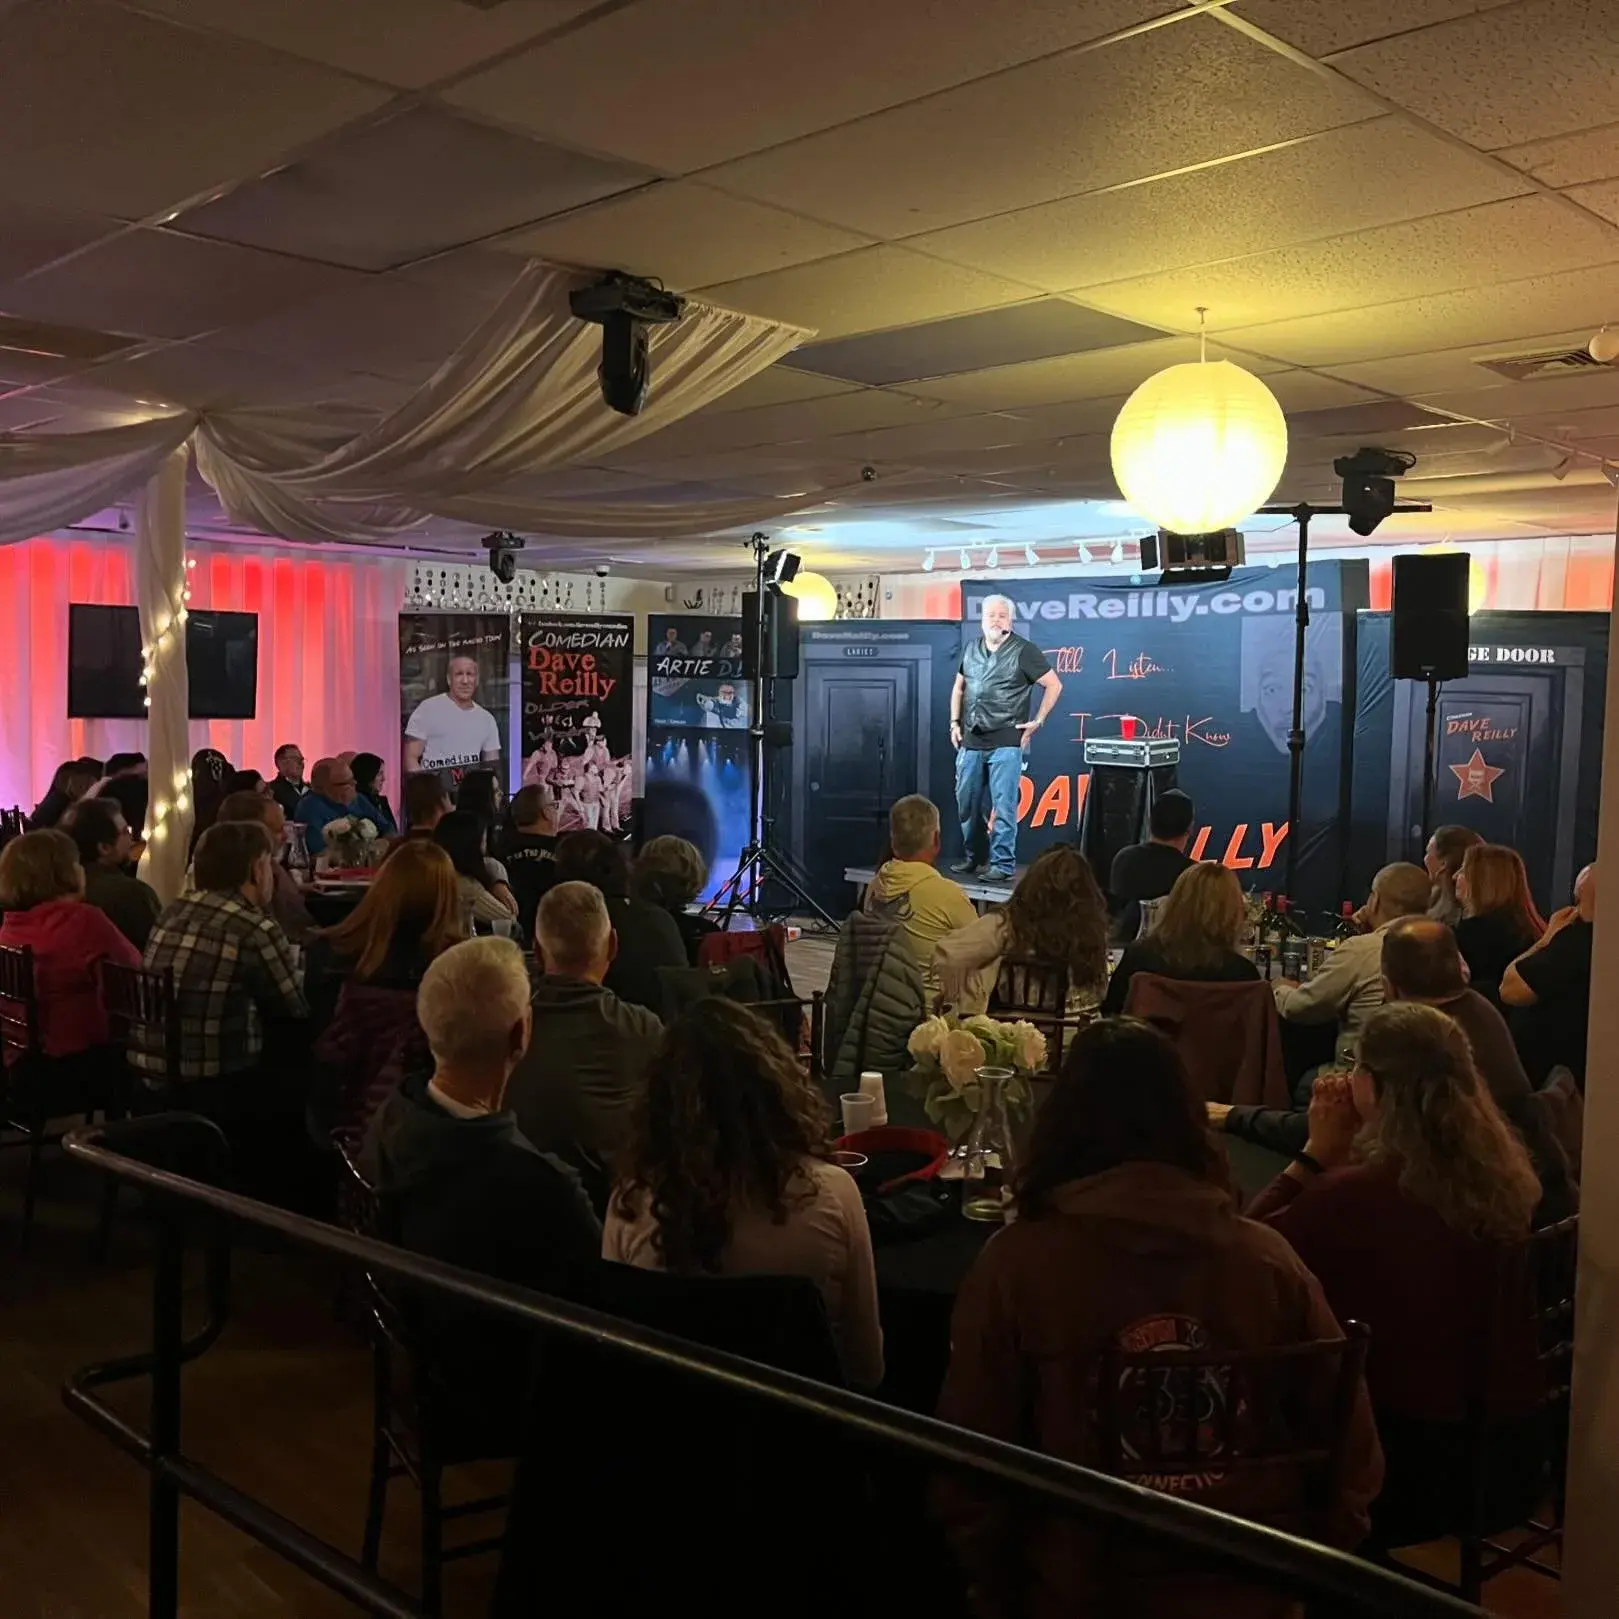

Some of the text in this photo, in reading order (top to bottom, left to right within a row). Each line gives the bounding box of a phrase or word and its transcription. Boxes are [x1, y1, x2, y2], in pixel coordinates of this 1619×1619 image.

[967, 587, 1325, 623] DveReilly.com
[528, 630, 630, 649] COMEDIAN
[528, 646, 596, 672] Dave
[1496, 647, 1556, 664] DOOR
[656, 657, 713, 677] ARTIE
[540, 670, 617, 701] Reilly
[1069, 713, 1092, 742] I
[1185, 714, 1232, 747] Know
[1447, 718, 1492, 735] DAVE
[1472, 728, 1518, 743] REILLY
[422, 753, 479, 769] Comedian
